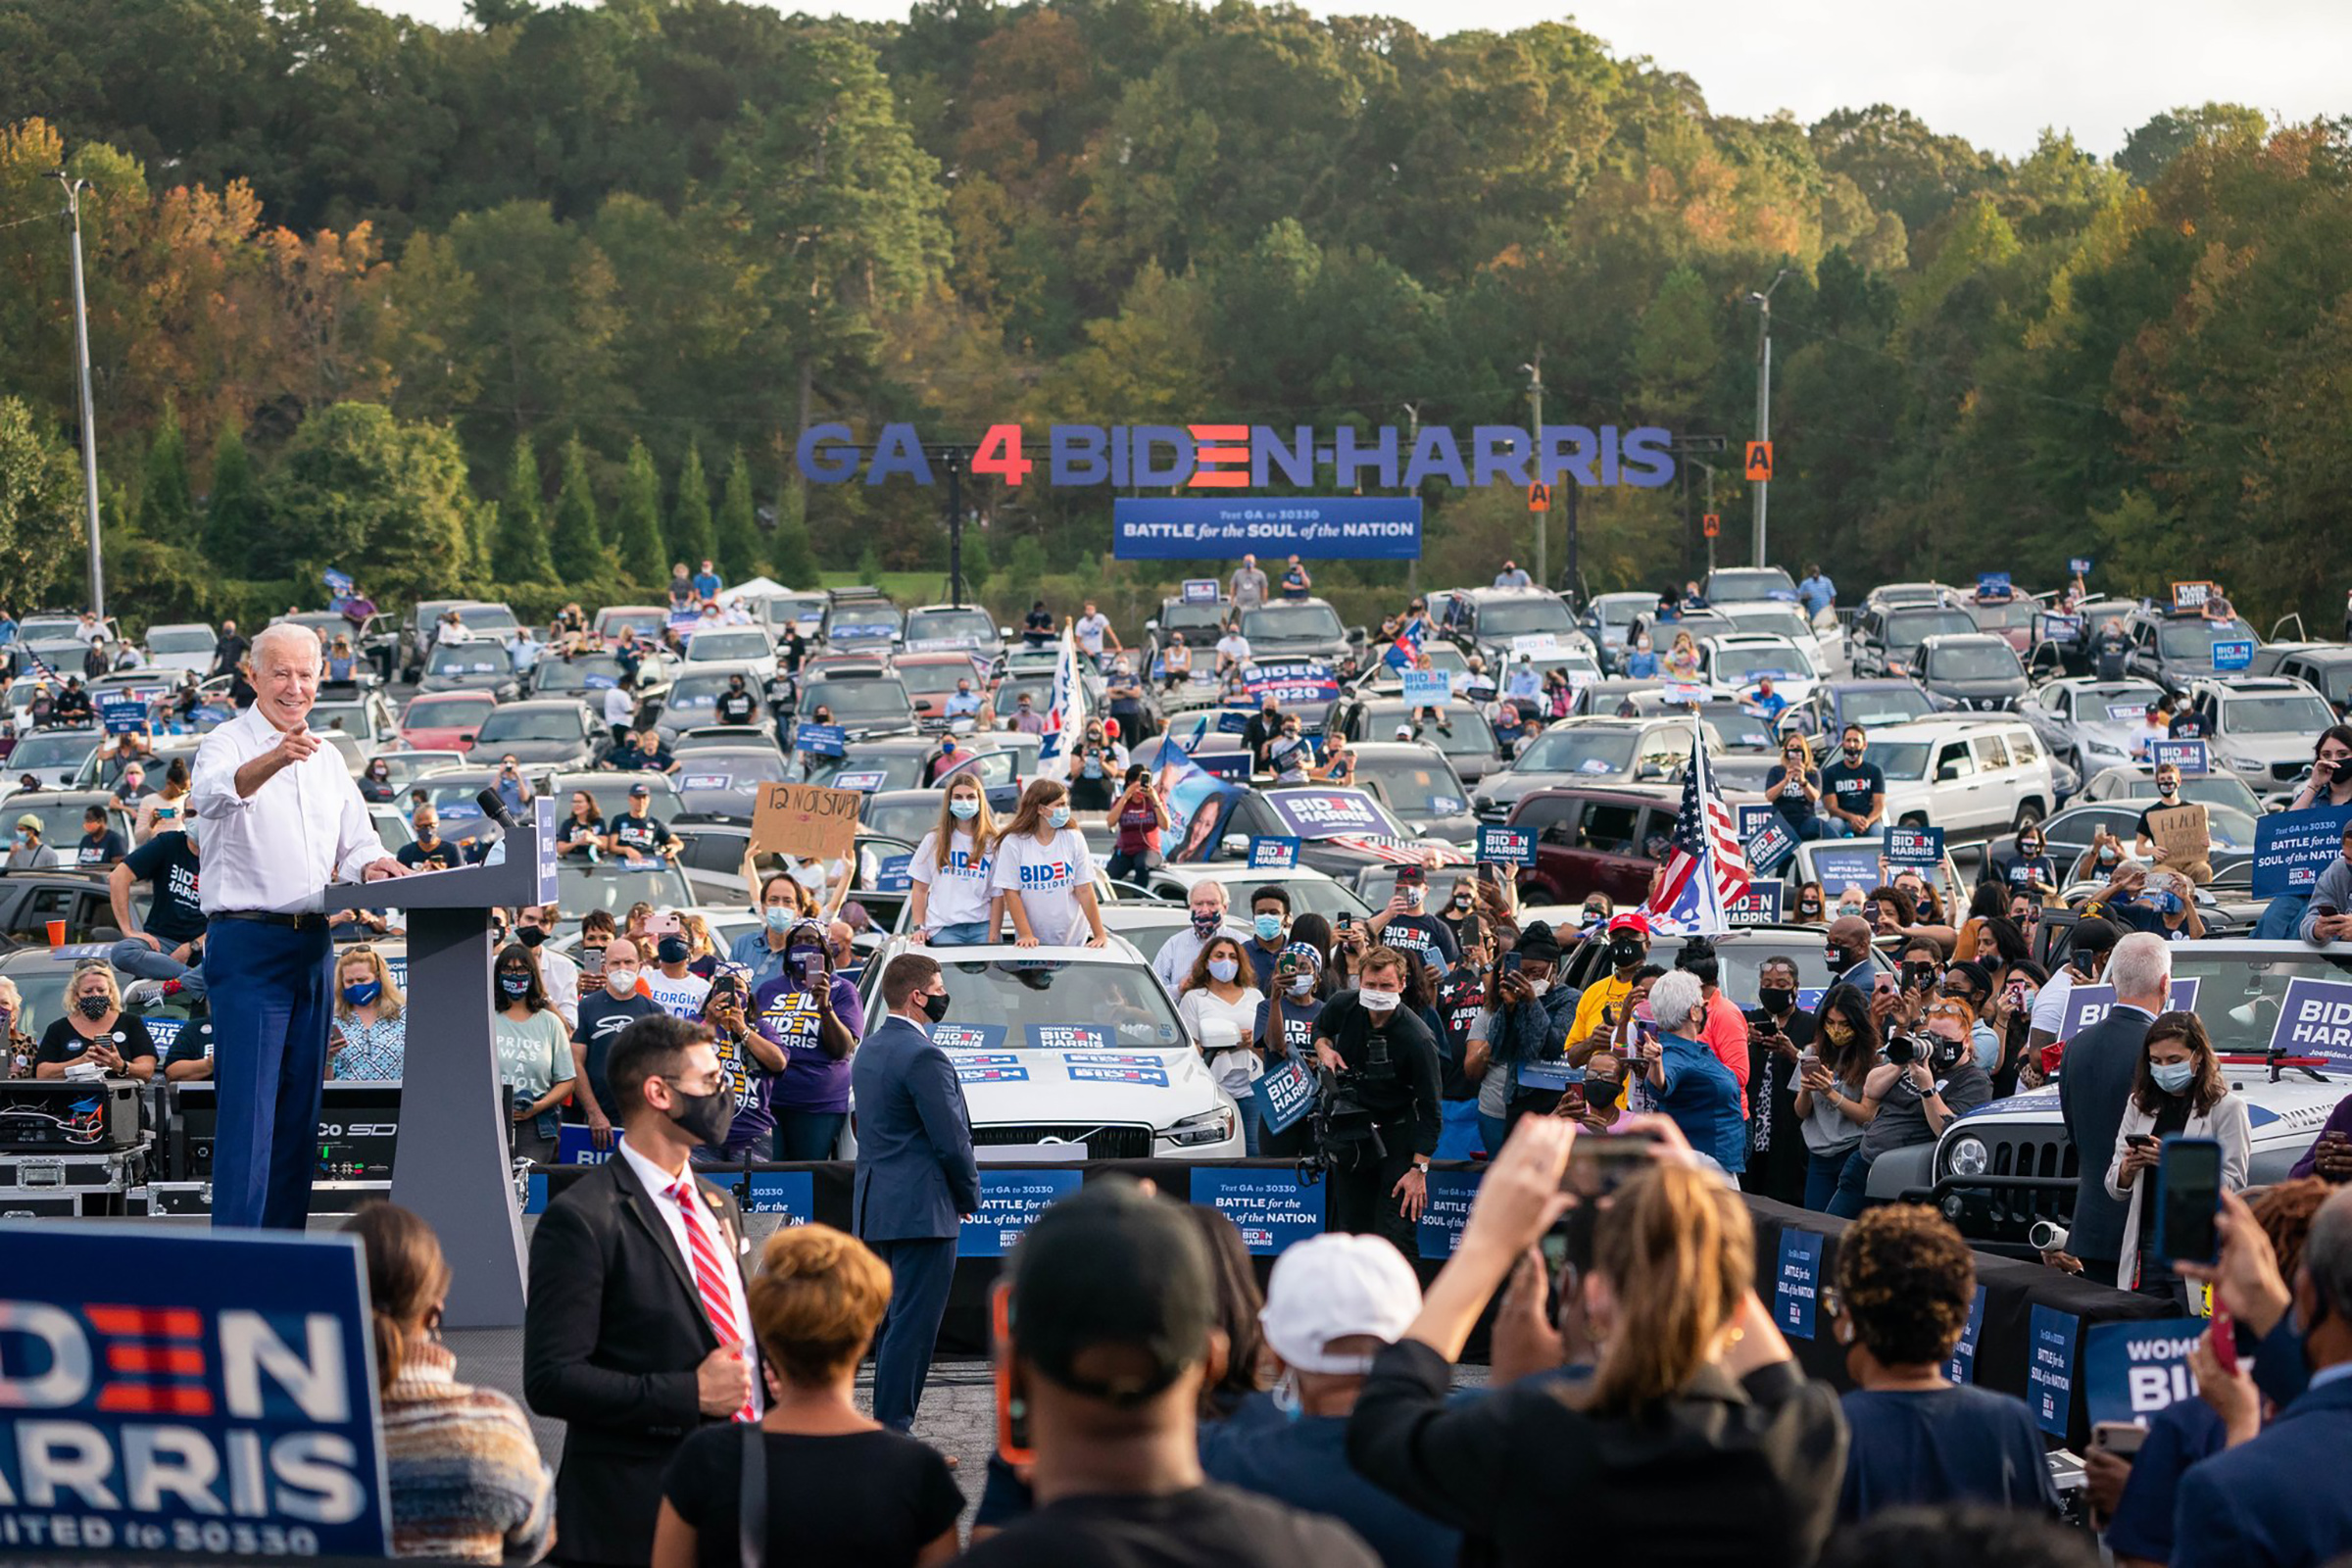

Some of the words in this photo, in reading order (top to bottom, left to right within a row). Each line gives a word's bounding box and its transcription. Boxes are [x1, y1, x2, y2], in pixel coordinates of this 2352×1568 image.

[797, 424, 933, 486] GA
[971, 424, 1032, 486] 4
[1748, 445, 1770, 470] A
[1531, 483, 1546, 503] A
[1244, 510, 1263, 520] GA
[1279, 510, 1320, 520] 30330
[1123, 523, 1196, 538] BATTLE
[1196, 522, 1221, 540] for
[1222, 522, 1246, 538] the
[1248, 522, 1298, 538] SOUL
[1299, 522, 1320, 540] of
[1318, 522, 1341, 538] the
[1343, 521, 1414, 537] NATION
[2217, 645, 2249, 655] BIDEN
[1246, 664, 1323, 682] BIDEN
[1404, 672, 1448, 684] BIDEN
[1405, 682, 1448, 691] HARRIS
[1260, 687, 1320, 701] 2020
[2159, 747, 2200, 757] BIDEN
[1836, 779, 1872, 792] BIDEN
[793, 788, 820, 814] NOT
[1285, 797, 1367, 812] BIDEN
[1294, 809, 1376, 824] HARRIS
[2309, 821, 2336, 831] 30330
[1486, 835, 1529, 846] BIDEN
[1749, 825, 1784, 858] BIDEN
[1891, 836, 1935, 847] BIDEN
[2271, 838, 2310, 851] BATTLE
[2310, 836, 2325, 848] for
[2326, 835, 2341, 845] the
[1256, 845, 1294, 857] BIDEN
[1486, 846, 1529, 856] HARRIS
[1753, 834, 1788, 865] HARRIS
[1891, 847, 1935, 856] HARRIS
[1255, 856, 1292, 865] HARRIS
[2258, 856, 2284, 867] SOUL
[2284, 853, 2295, 864] of
[2294, 853, 2309, 862] the
[2310, 850, 2344, 860] NATIO
[171, 863, 199, 889] BIDE
[1020, 861, 1073, 882] BIDEN
[2288, 870, 2316, 879] BIDEN
[1385, 926, 1431, 942] BIDEN
[1383, 938, 1430, 952] HARRIS
[503, 980, 529, 989] BIDEN
[652, 990, 699, 1006] EORGIA
[2298, 1000, 2352, 1026] BID
[781, 1034, 818, 1050] RRIS
[933, 1032, 985, 1042] BIDEN
[933, 1039, 983, 1048] HARRIS
[1040, 1031, 1102, 1042] BIDEN
[2291, 1026, 2352, 1047] HAR
[496, 1035, 542, 1053] PRIDE
[1041, 1040, 1104, 1049] HARRIS
[500, 1048, 538, 1061] WAS
[514, 1061, 525, 1075] A
[721, 1059, 741, 1071] FOR
[501, 1074, 537, 1088] RIOT
[1264, 1065, 1290, 1087] WOMEN
[734, 1093, 760, 1109] RIS
[1239, 1184, 1253, 1193] GA
[1265, 1184, 1297, 1193] 30330
[754, 1201, 770, 1213] for
[772, 1201, 788, 1211] the
[980, 1200, 1023, 1209] ATTLE
[1023, 1200, 1040, 1211] for
[1215, 1198, 1265, 1207] BATTLE
[1266, 1199, 1283, 1210] for
[1285, 1199, 1301, 1208] the
[1434, 1201, 1467, 1212] BATTLE
[994, 1214, 1005, 1226] of
[1005, 1214, 1022, 1224] the
[1236, 1212, 1248, 1224] of
[1248, 1212, 1264, 1223] the
[1266, 1213, 1317, 1223] NATION
[1422, 1215, 1446, 1226] SOUL
[1446, 1217, 1455, 1229] of
[1454, 1217, 1465, 1227] the
[1785, 1264, 1799, 1278] BATTLE
[1779, 1281, 1789, 1294] SOUL
[1797, 1285, 1815, 1298] NATION
[0, 1299, 353, 1423] DEN
[2037, 1348, 2053, 1364] BATTLE
[2032, 1366, 2042, 1382] SOUL
[2051, 1373, 2069, 1391] NATION
[0, 1420, 368, 1525] RRIS
[0, 1514, 116, 1548] ITED
[124, 1520, 165, 1549] to
[173, 1518, 319, 1557] 30330
